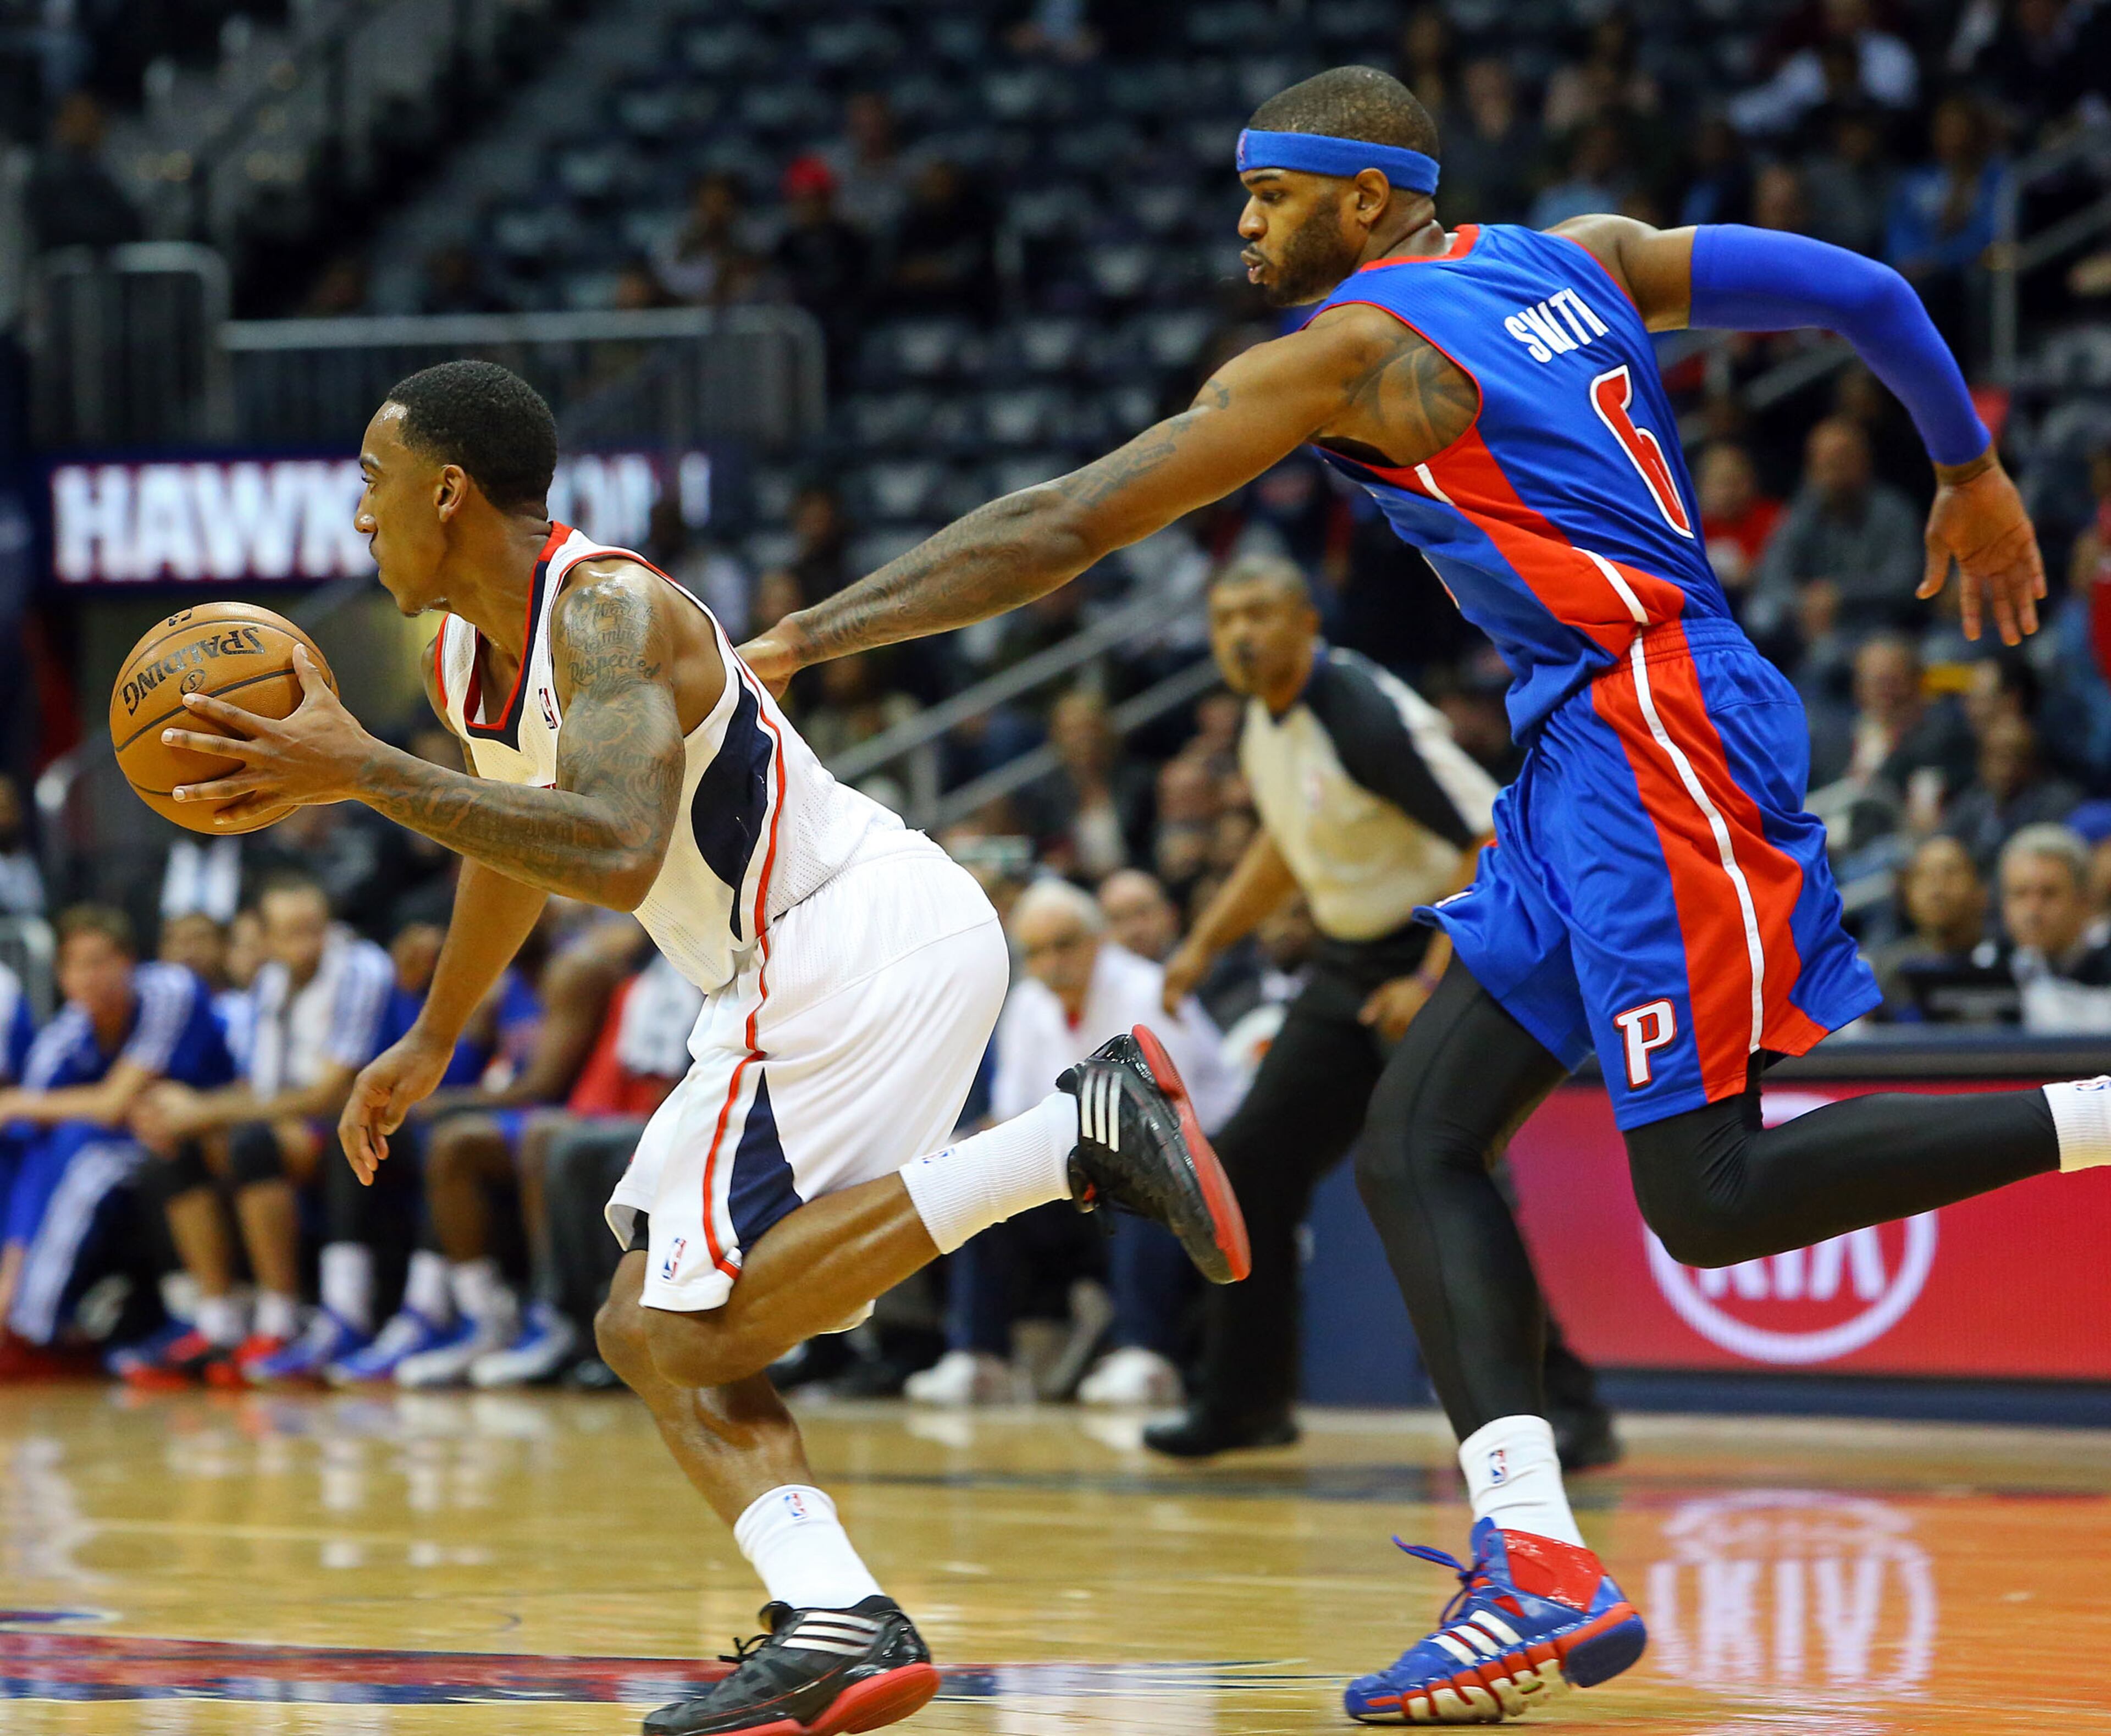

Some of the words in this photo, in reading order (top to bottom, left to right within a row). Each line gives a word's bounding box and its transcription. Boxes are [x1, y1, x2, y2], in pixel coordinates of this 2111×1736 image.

[1590, 363, 1695, 539] 6
[51, 460, 378, 583] HAWK
[121, 626, 266, 716] SPALDING
[1613, 998, 1677, 1091] P
